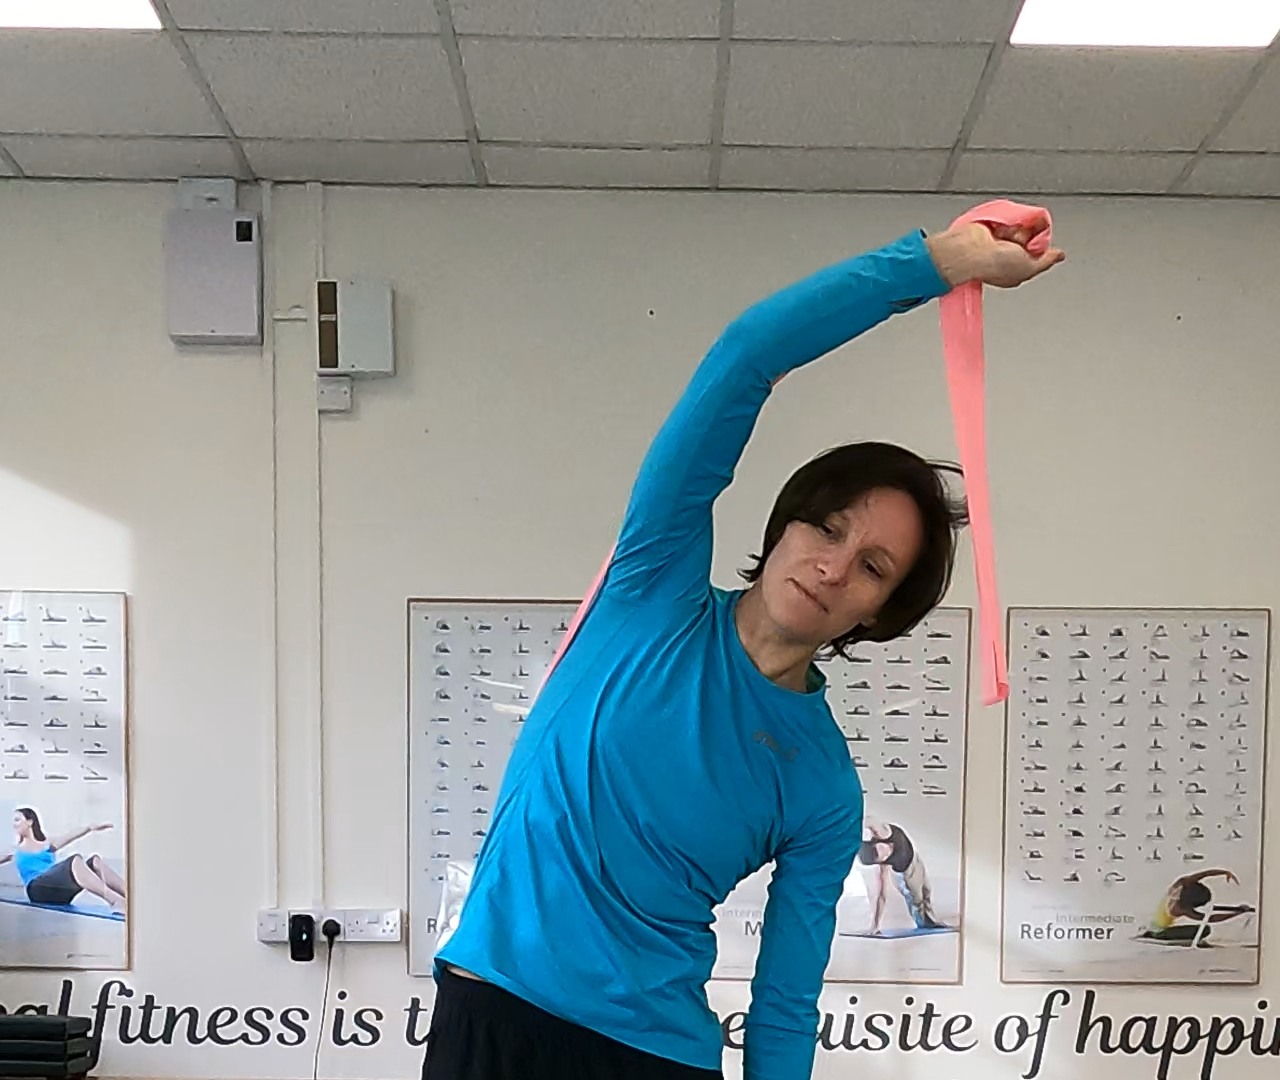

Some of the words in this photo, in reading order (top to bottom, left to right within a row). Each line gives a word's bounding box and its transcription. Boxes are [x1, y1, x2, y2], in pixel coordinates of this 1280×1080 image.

[1020, 922, 1114, 940] Reformer
[86, 979, 310, 1071] fitness
[331, 990, 383, 1047] is
[993, 989, 1071, 1080] of
